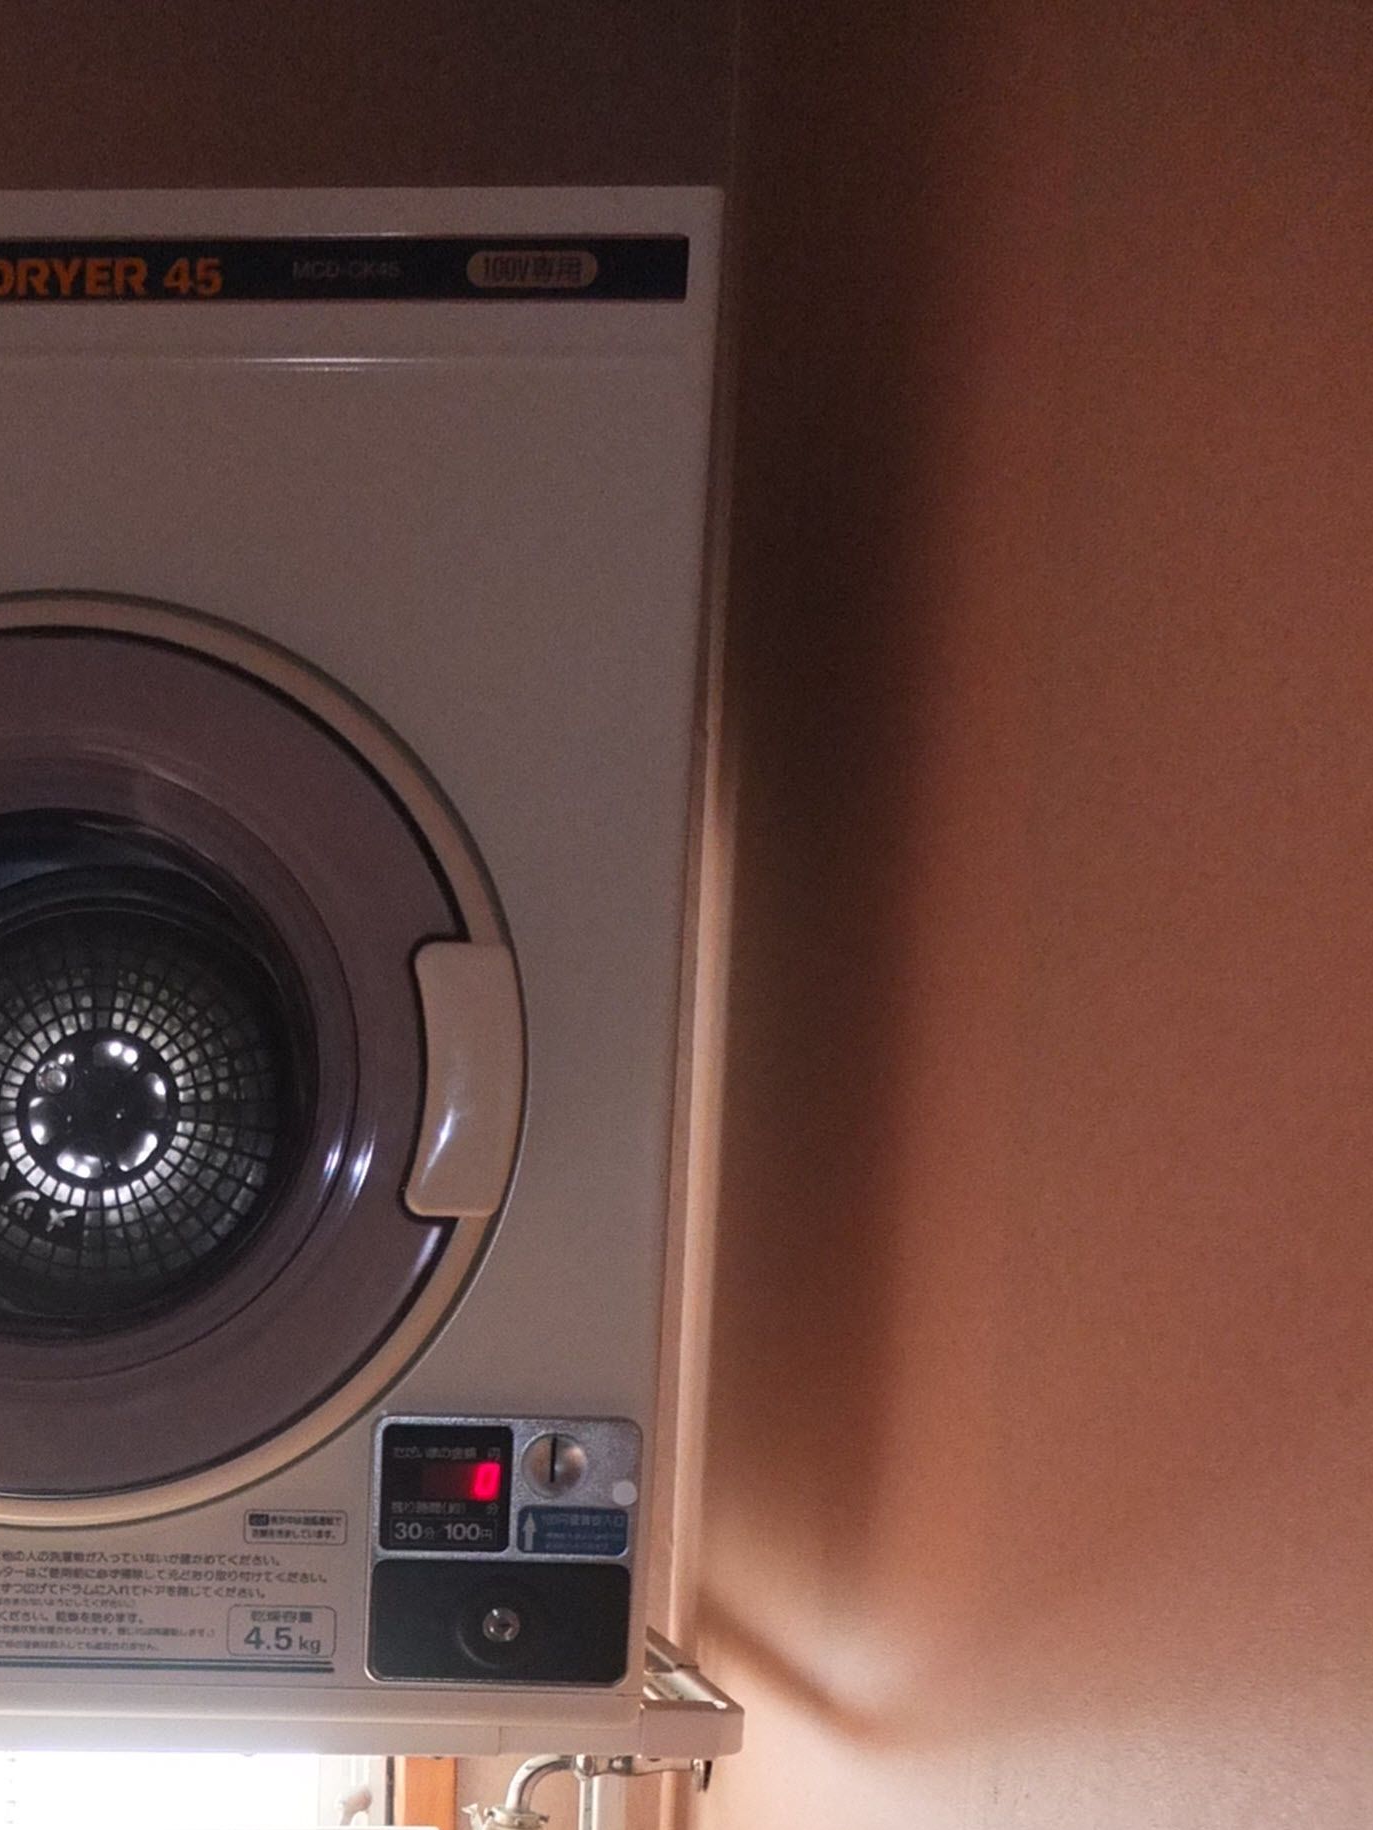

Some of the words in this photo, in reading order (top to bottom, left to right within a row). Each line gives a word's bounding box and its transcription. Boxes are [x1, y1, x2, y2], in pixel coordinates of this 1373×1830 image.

[163, 256, 225, 295] 45
[473, 1461, 502, 1503] 0
[243, 1626, 293, 1652] 4.5
[299, 1634, 322, 1656] kg
